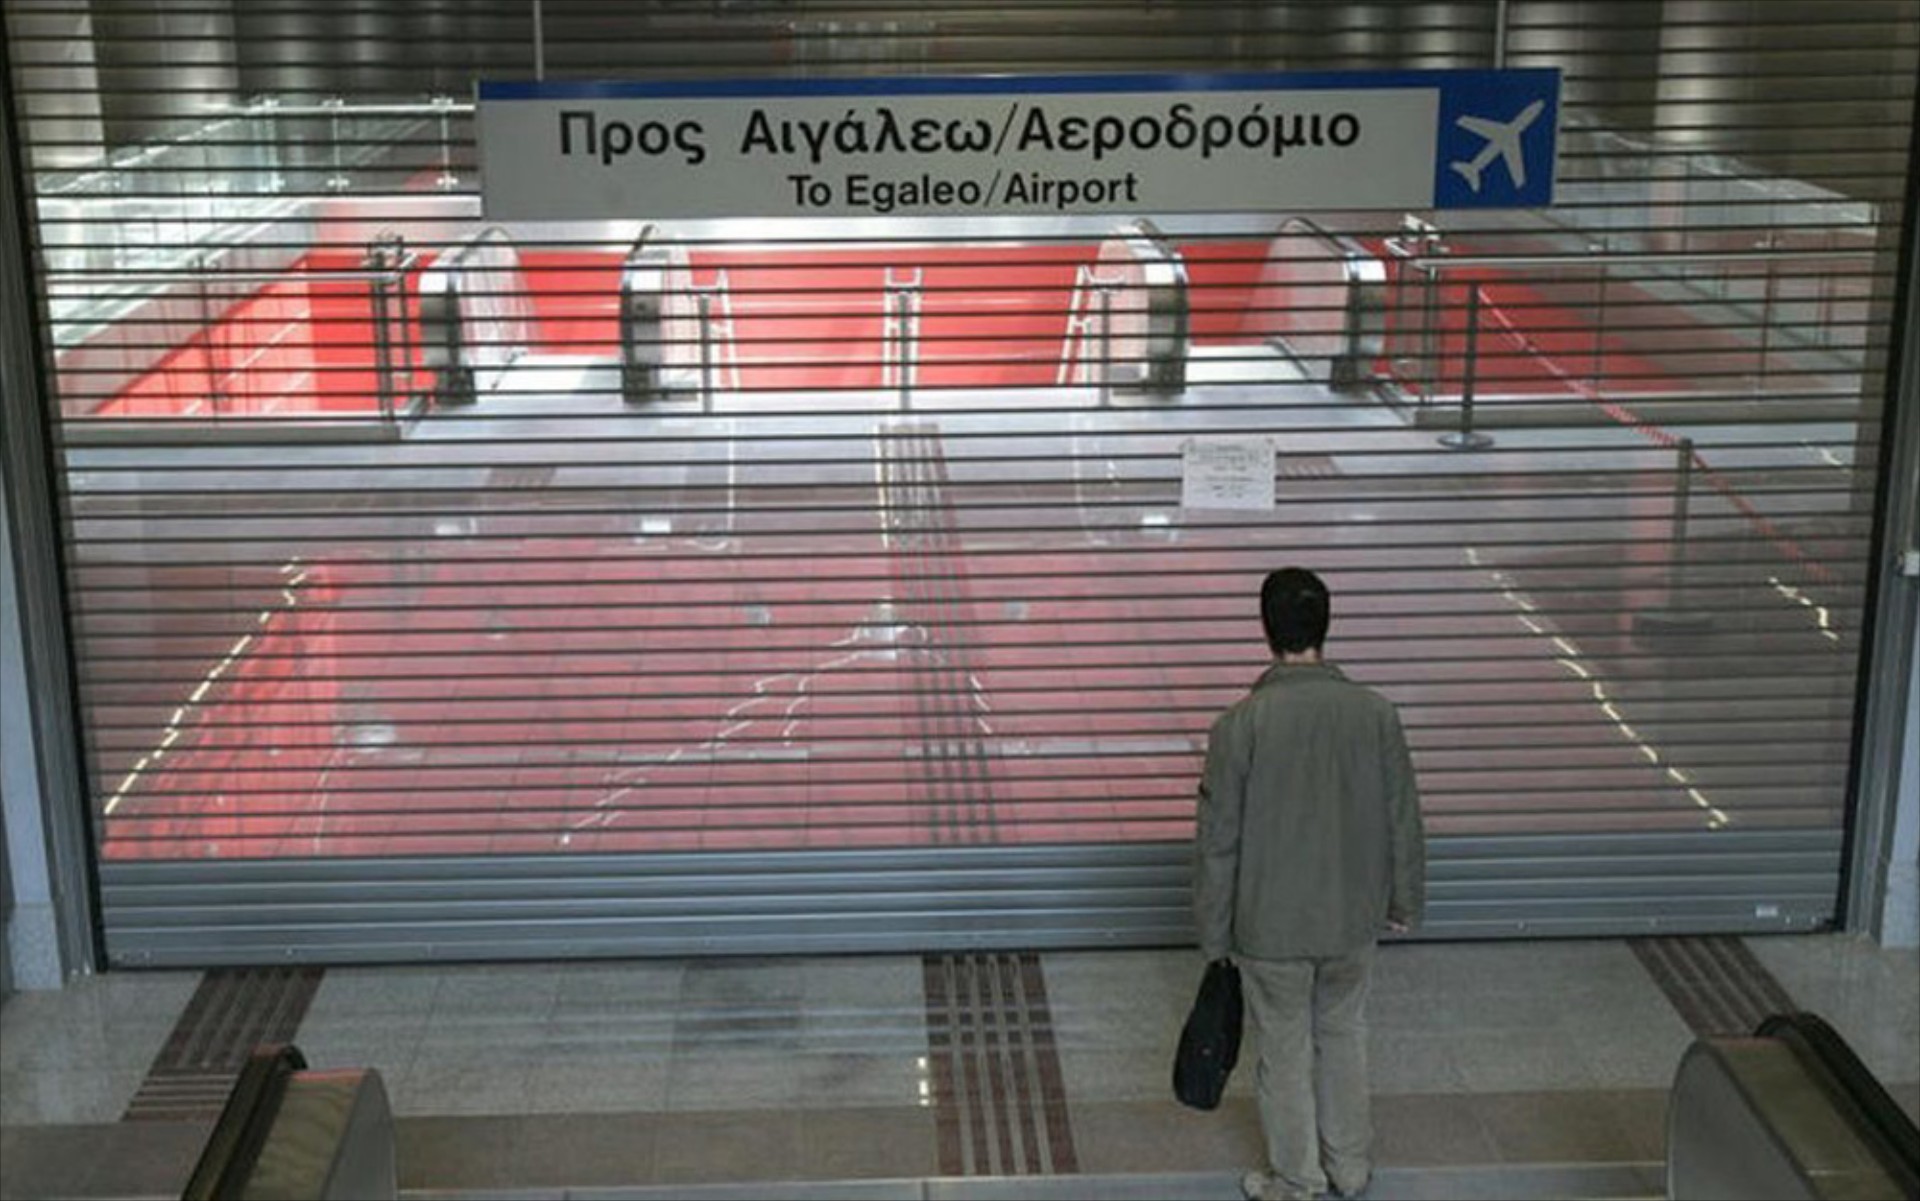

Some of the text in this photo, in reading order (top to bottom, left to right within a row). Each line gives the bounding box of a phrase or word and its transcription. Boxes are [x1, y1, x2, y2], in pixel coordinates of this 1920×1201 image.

[558, 102, 1361, 166] Προς Αιγάλεω/Αεροδρόμιο
[786, 171, 1138, 214] To Egaleo/Airport
